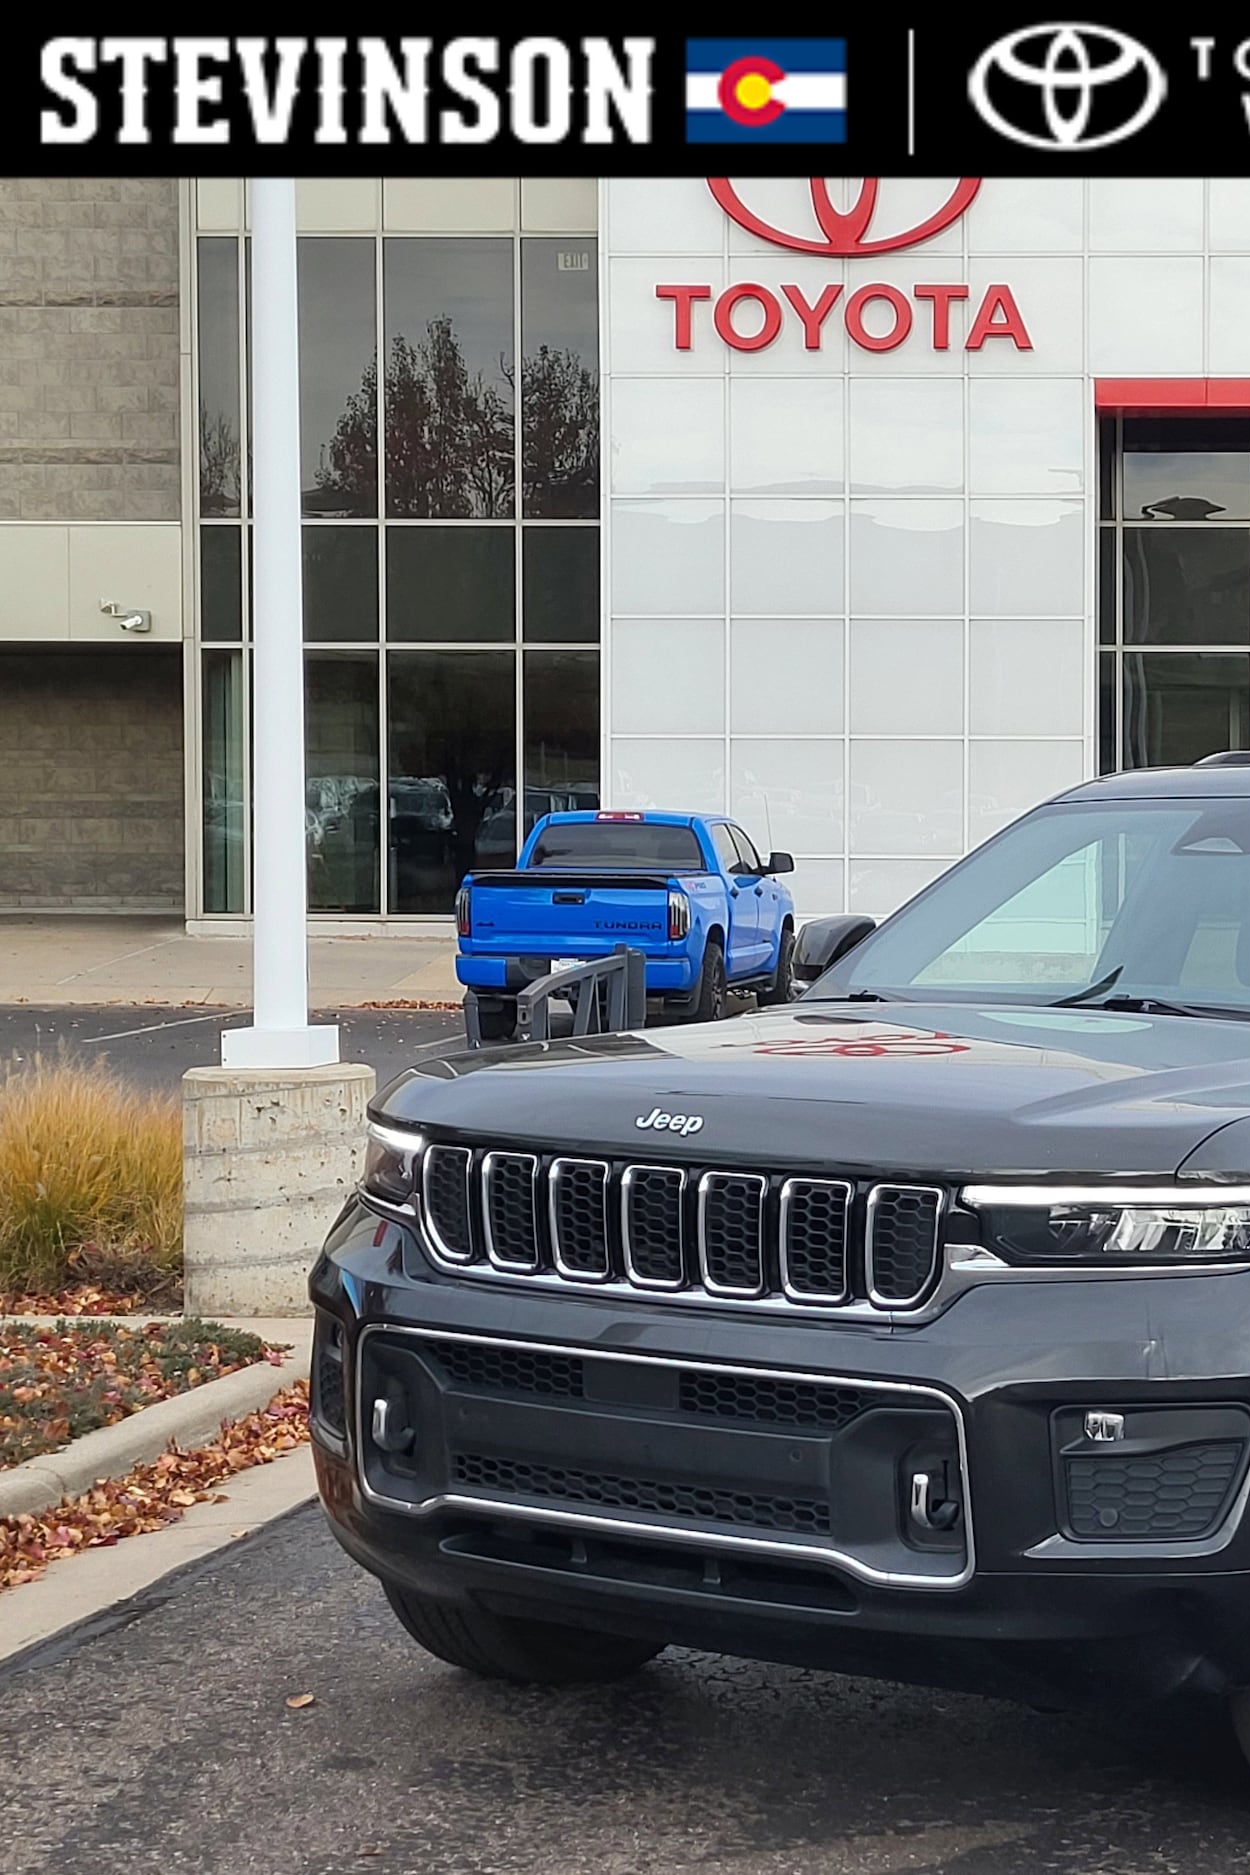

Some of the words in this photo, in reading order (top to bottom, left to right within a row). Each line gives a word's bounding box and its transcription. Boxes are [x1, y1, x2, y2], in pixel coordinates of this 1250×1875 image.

[655, 282, 1032, 353] TOYOTA
[594, 920, 663, 930] TUNDRA
[635, 1107, 704, 1136] Jeep
